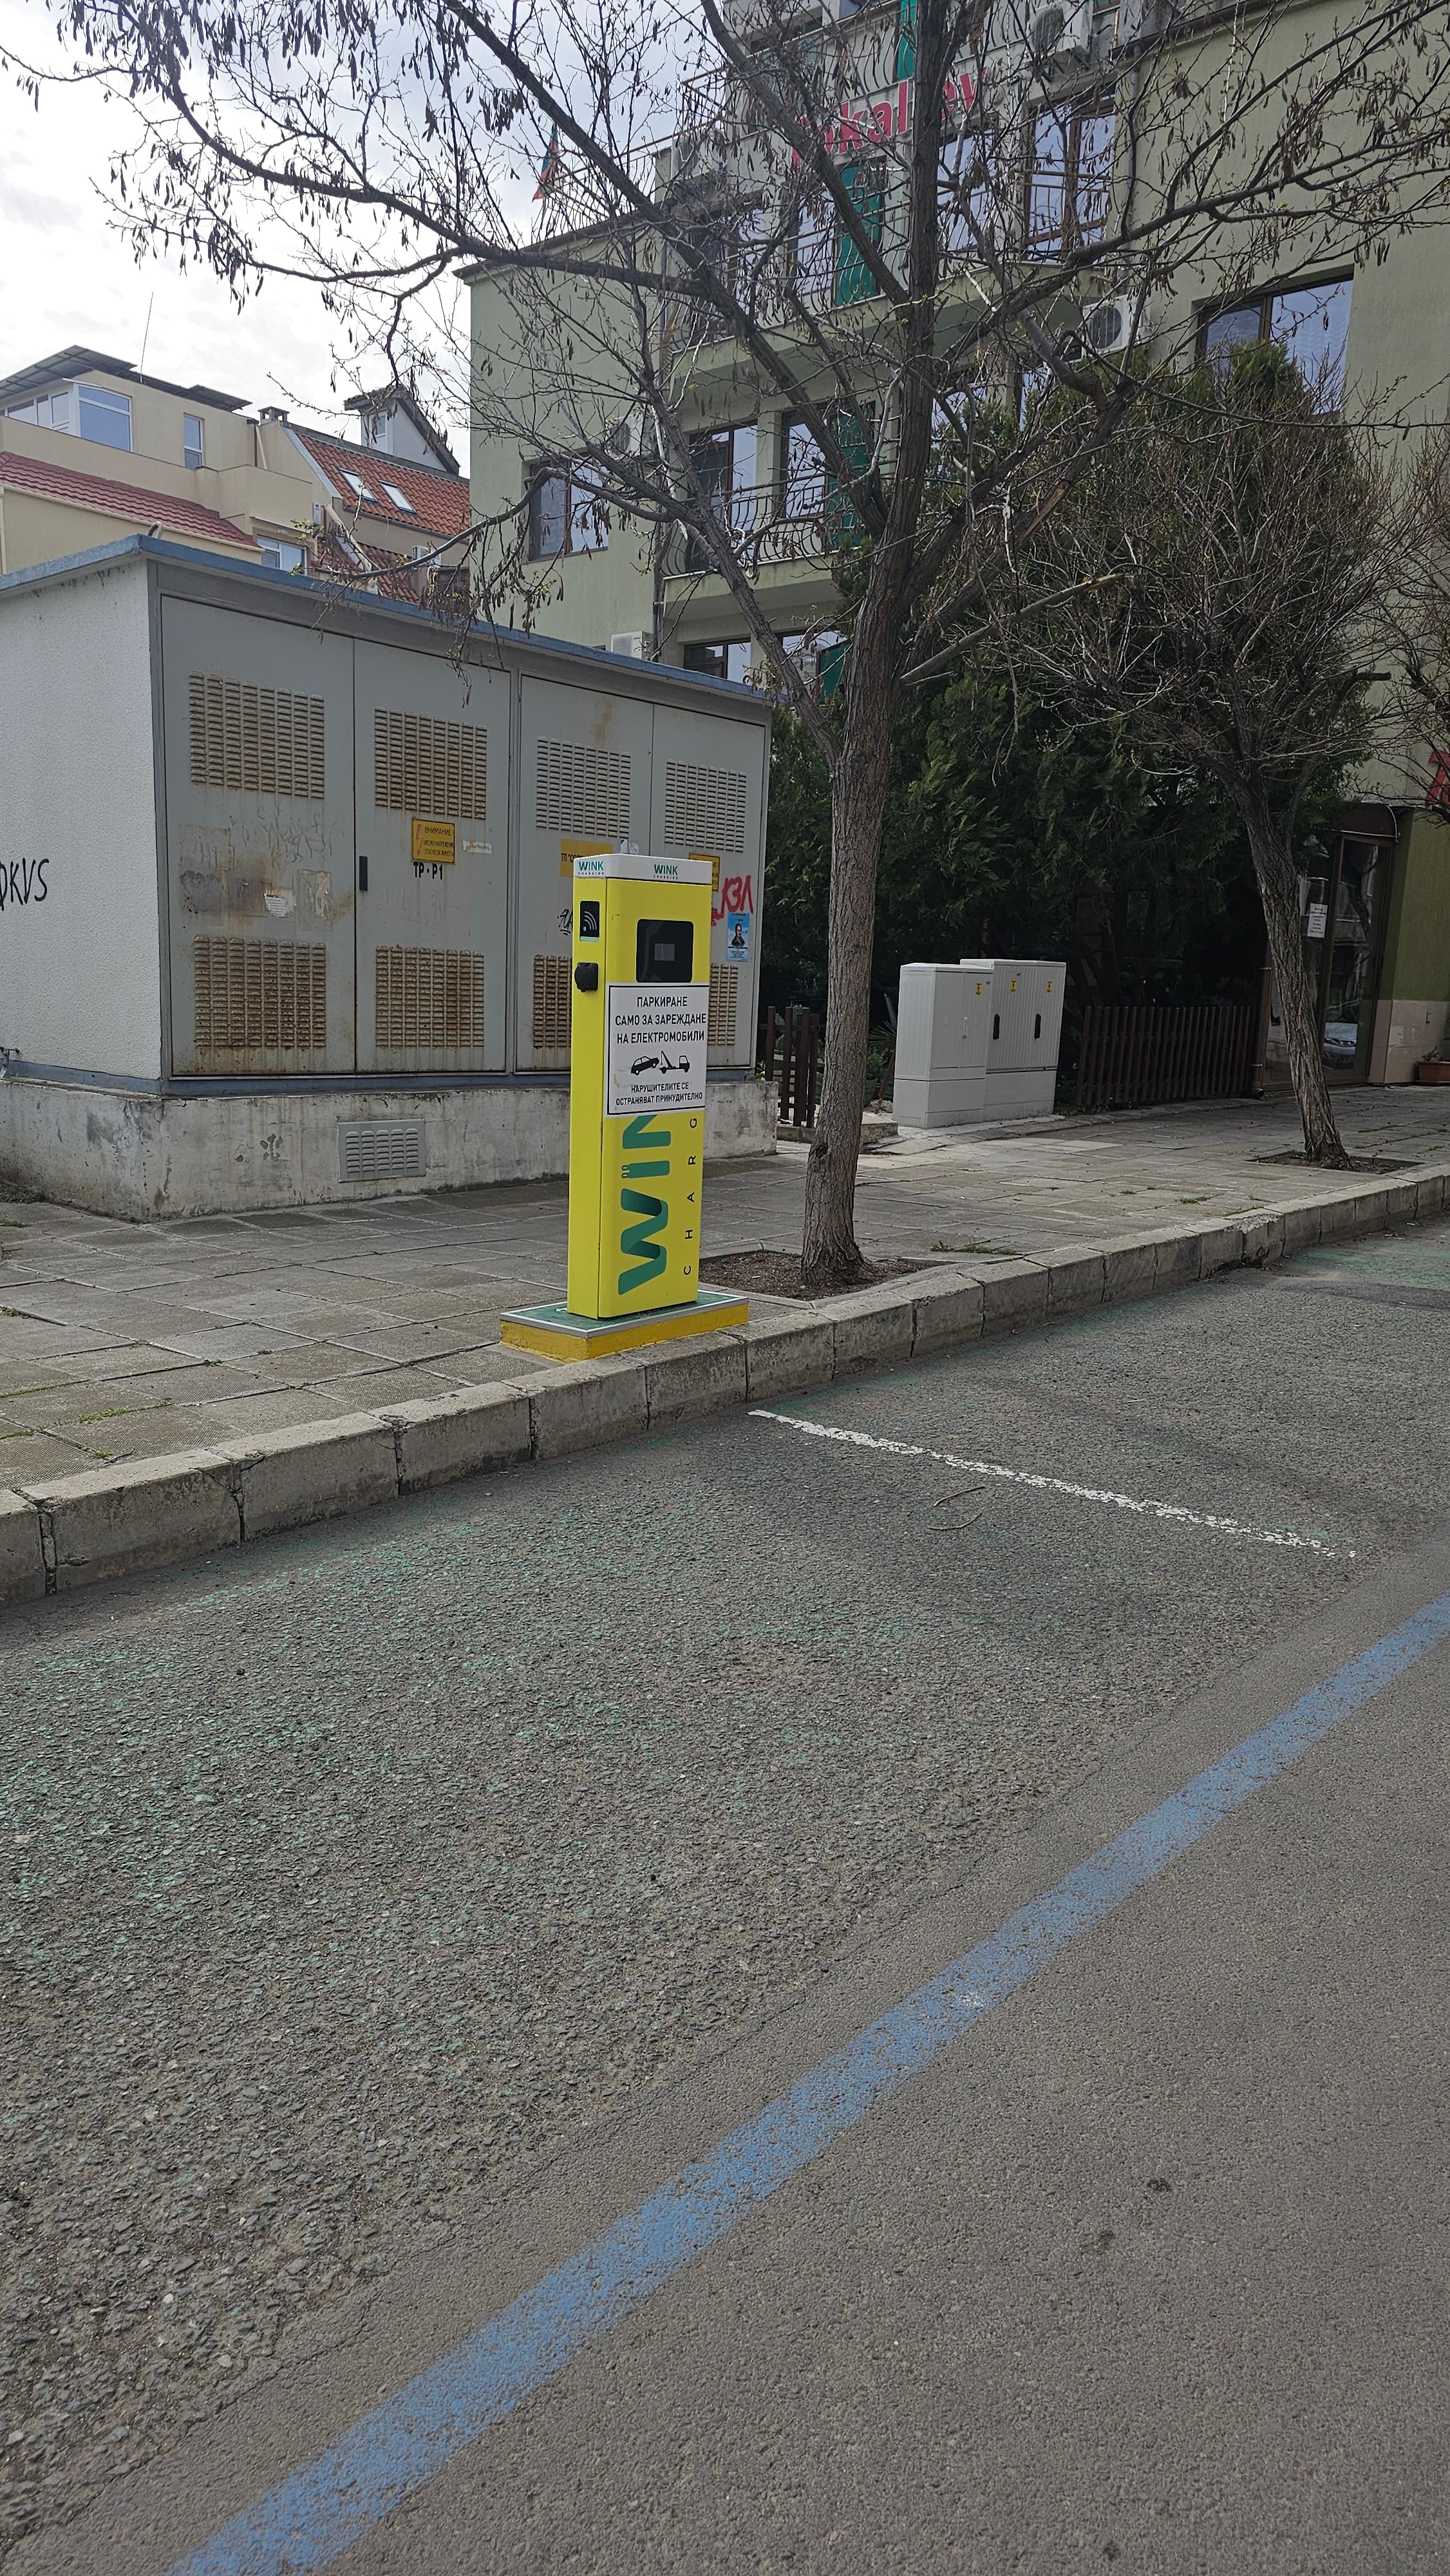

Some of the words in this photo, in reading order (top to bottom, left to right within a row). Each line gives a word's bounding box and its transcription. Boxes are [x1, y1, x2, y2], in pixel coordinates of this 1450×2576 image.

[579, 861, 604, 871] WINK
[654, 864, 678, 875] WINK
[637, 996, 688, 1007] ПАРКИРАНЕ
[615, 1014, 640, 1025] САМО
[642, 1014, 653, 1025] ЗА
[655, 1013, 706, 1026] ЗАРЕЖДАНЕ
[617, 1033, 629, 1044] НА
[631, 1030, 704, 1043] ЕЛЕКТРОМОБИЛИ
[631, 1083, 681, 1093] НАРУШИТЕЛИТЕ
[616, 1095, 654, 1106] ОСТРАНЯВАТ
[655, 1092, 702, 1103] ПРИНУДИТЕЛНО
